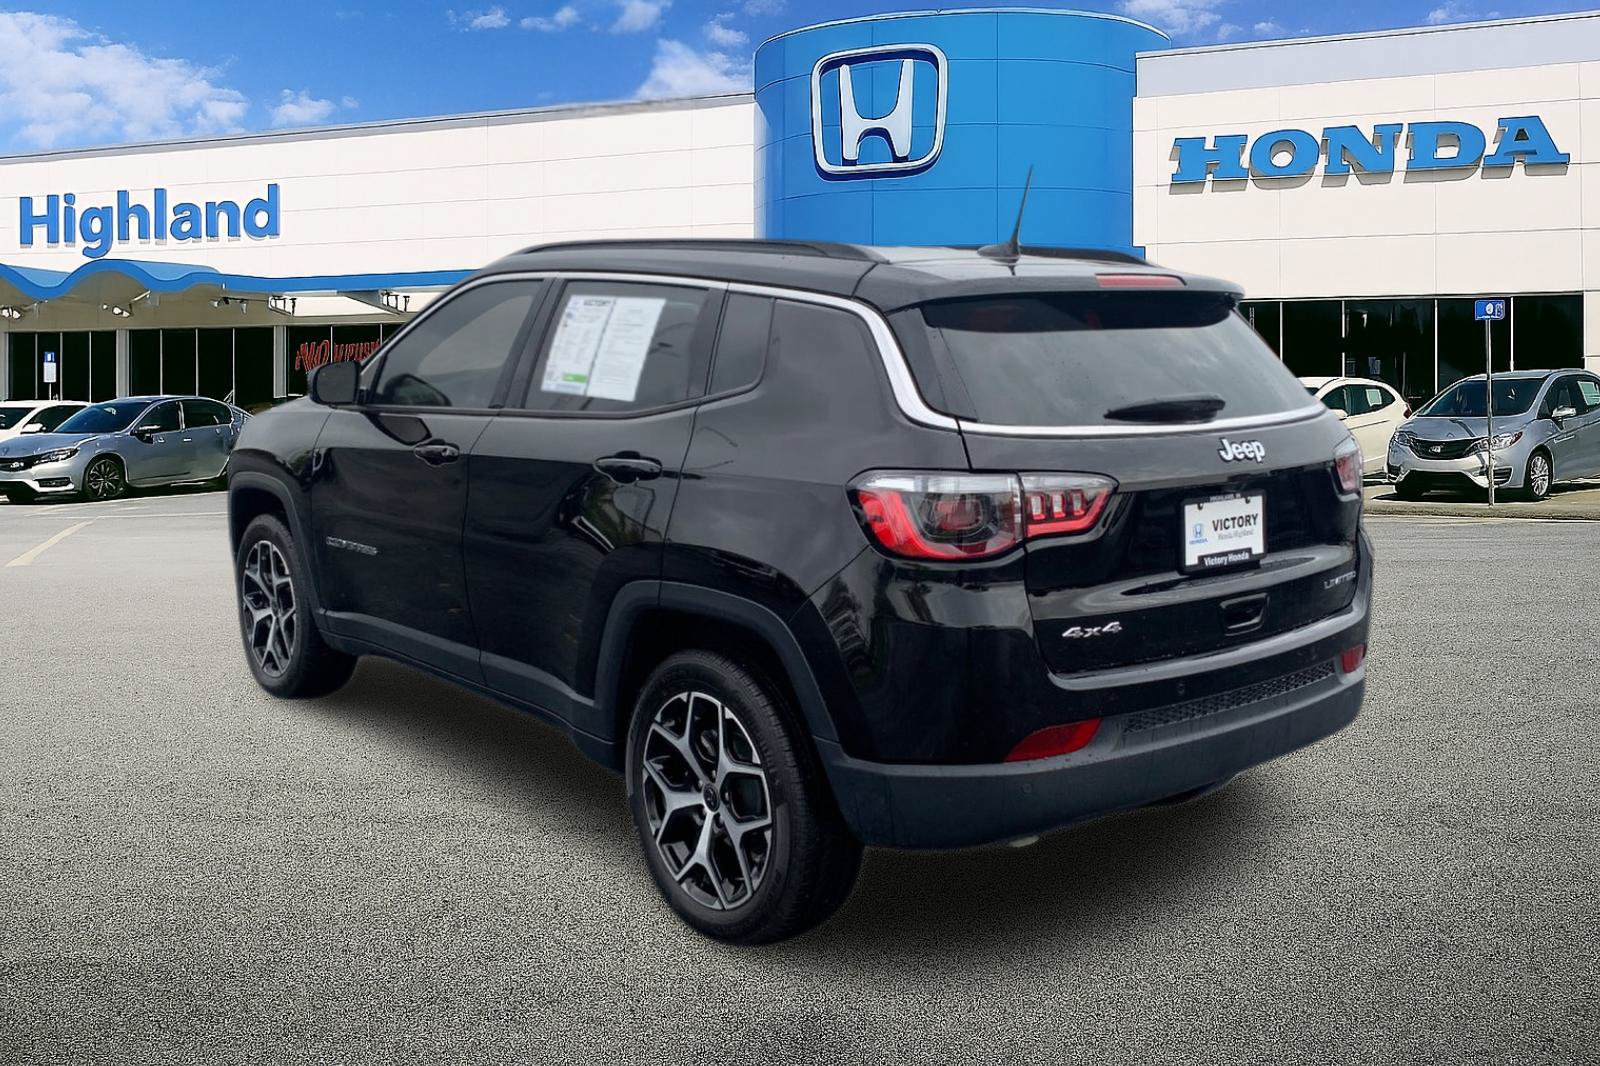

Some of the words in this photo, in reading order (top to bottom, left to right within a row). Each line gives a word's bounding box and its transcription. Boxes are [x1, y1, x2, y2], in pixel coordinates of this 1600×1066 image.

[1170, 115, 1571, 188] HONDA
[19, 183, 280, 257] Highland
[1218, 437, 1266, 463] Jeep
[1212, 513, 1259, 532] VICTORY
[1203, 556, 1228, 567] Victory
[1228, 551, 1250, 562] Honda
